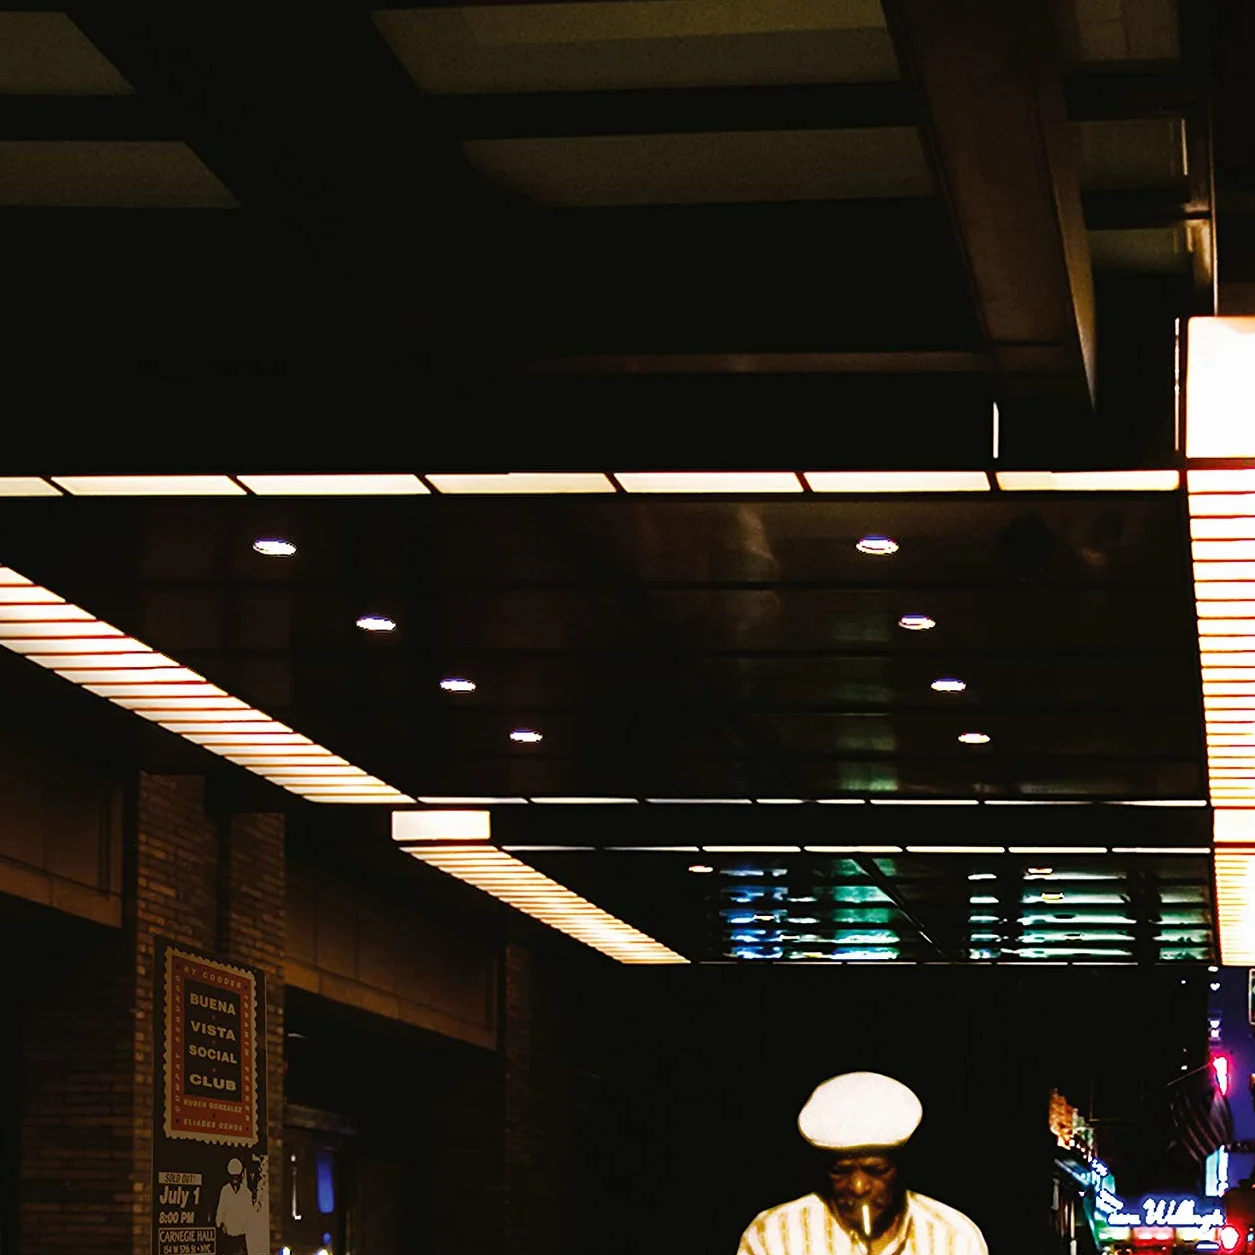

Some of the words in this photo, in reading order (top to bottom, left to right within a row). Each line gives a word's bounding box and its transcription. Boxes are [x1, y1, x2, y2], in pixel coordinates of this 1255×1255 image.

[202, 970, 242, 989] COODER
[190, 992, 236, 1016] BUENA
[190, 1019, 237, 1041] VISTA
[188, 1044, 238, 1064] SOCIAL
[189, 1073, 237, 1092] CLUB
[183, 1118, 216, 1129] ELIADES
[218, 1120, 243, 1132] OCHOA
[164, 1173, 181, 1183] SOLD
[160, 1185, 190, 1208] July
[193, 1186, 200, 1205] 1
[159, 1210, 179, 1224] 8:00
[181, 1211, 195, 1224] PM
[160, 1230, 196, 1243] CARNEGIE
[197, 1230, 215, 1241] HALL
